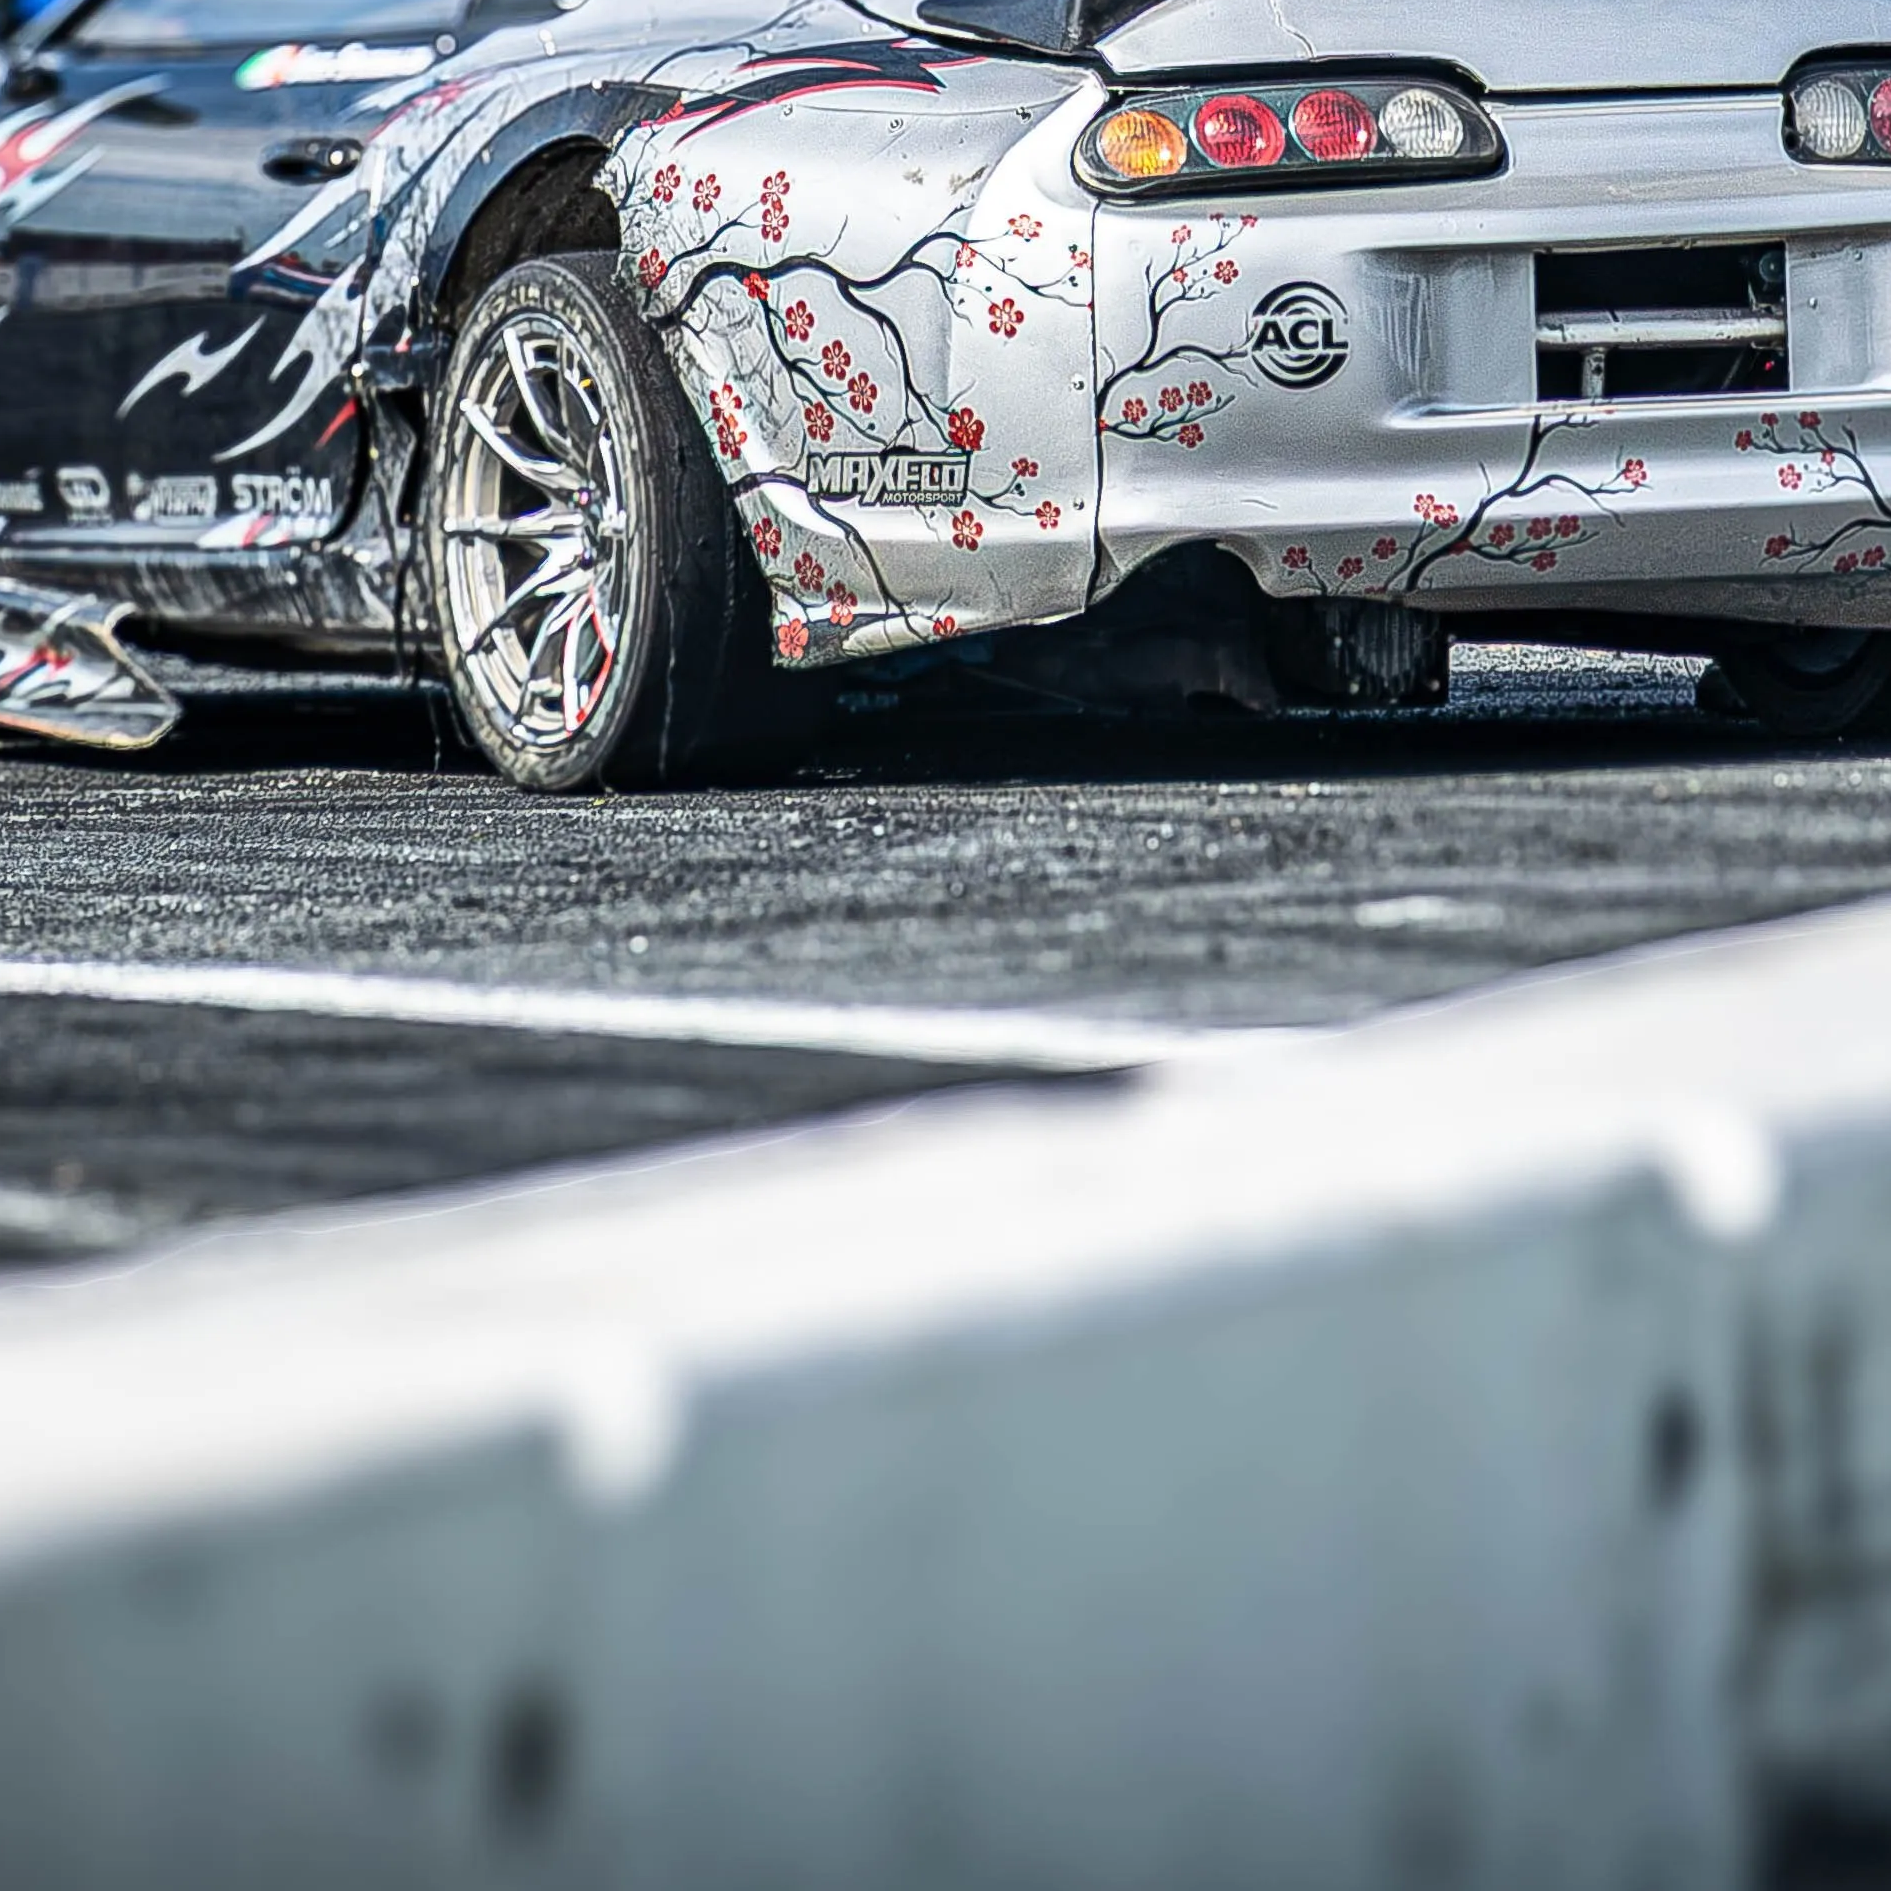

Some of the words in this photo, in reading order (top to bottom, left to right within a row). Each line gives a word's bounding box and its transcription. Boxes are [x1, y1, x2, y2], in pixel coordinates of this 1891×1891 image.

[1251, 317, 1349, 351] ACL
[808, 455, 968, 504] MAXFLO
[881, 491, 964, 504] MOTORSPORT
